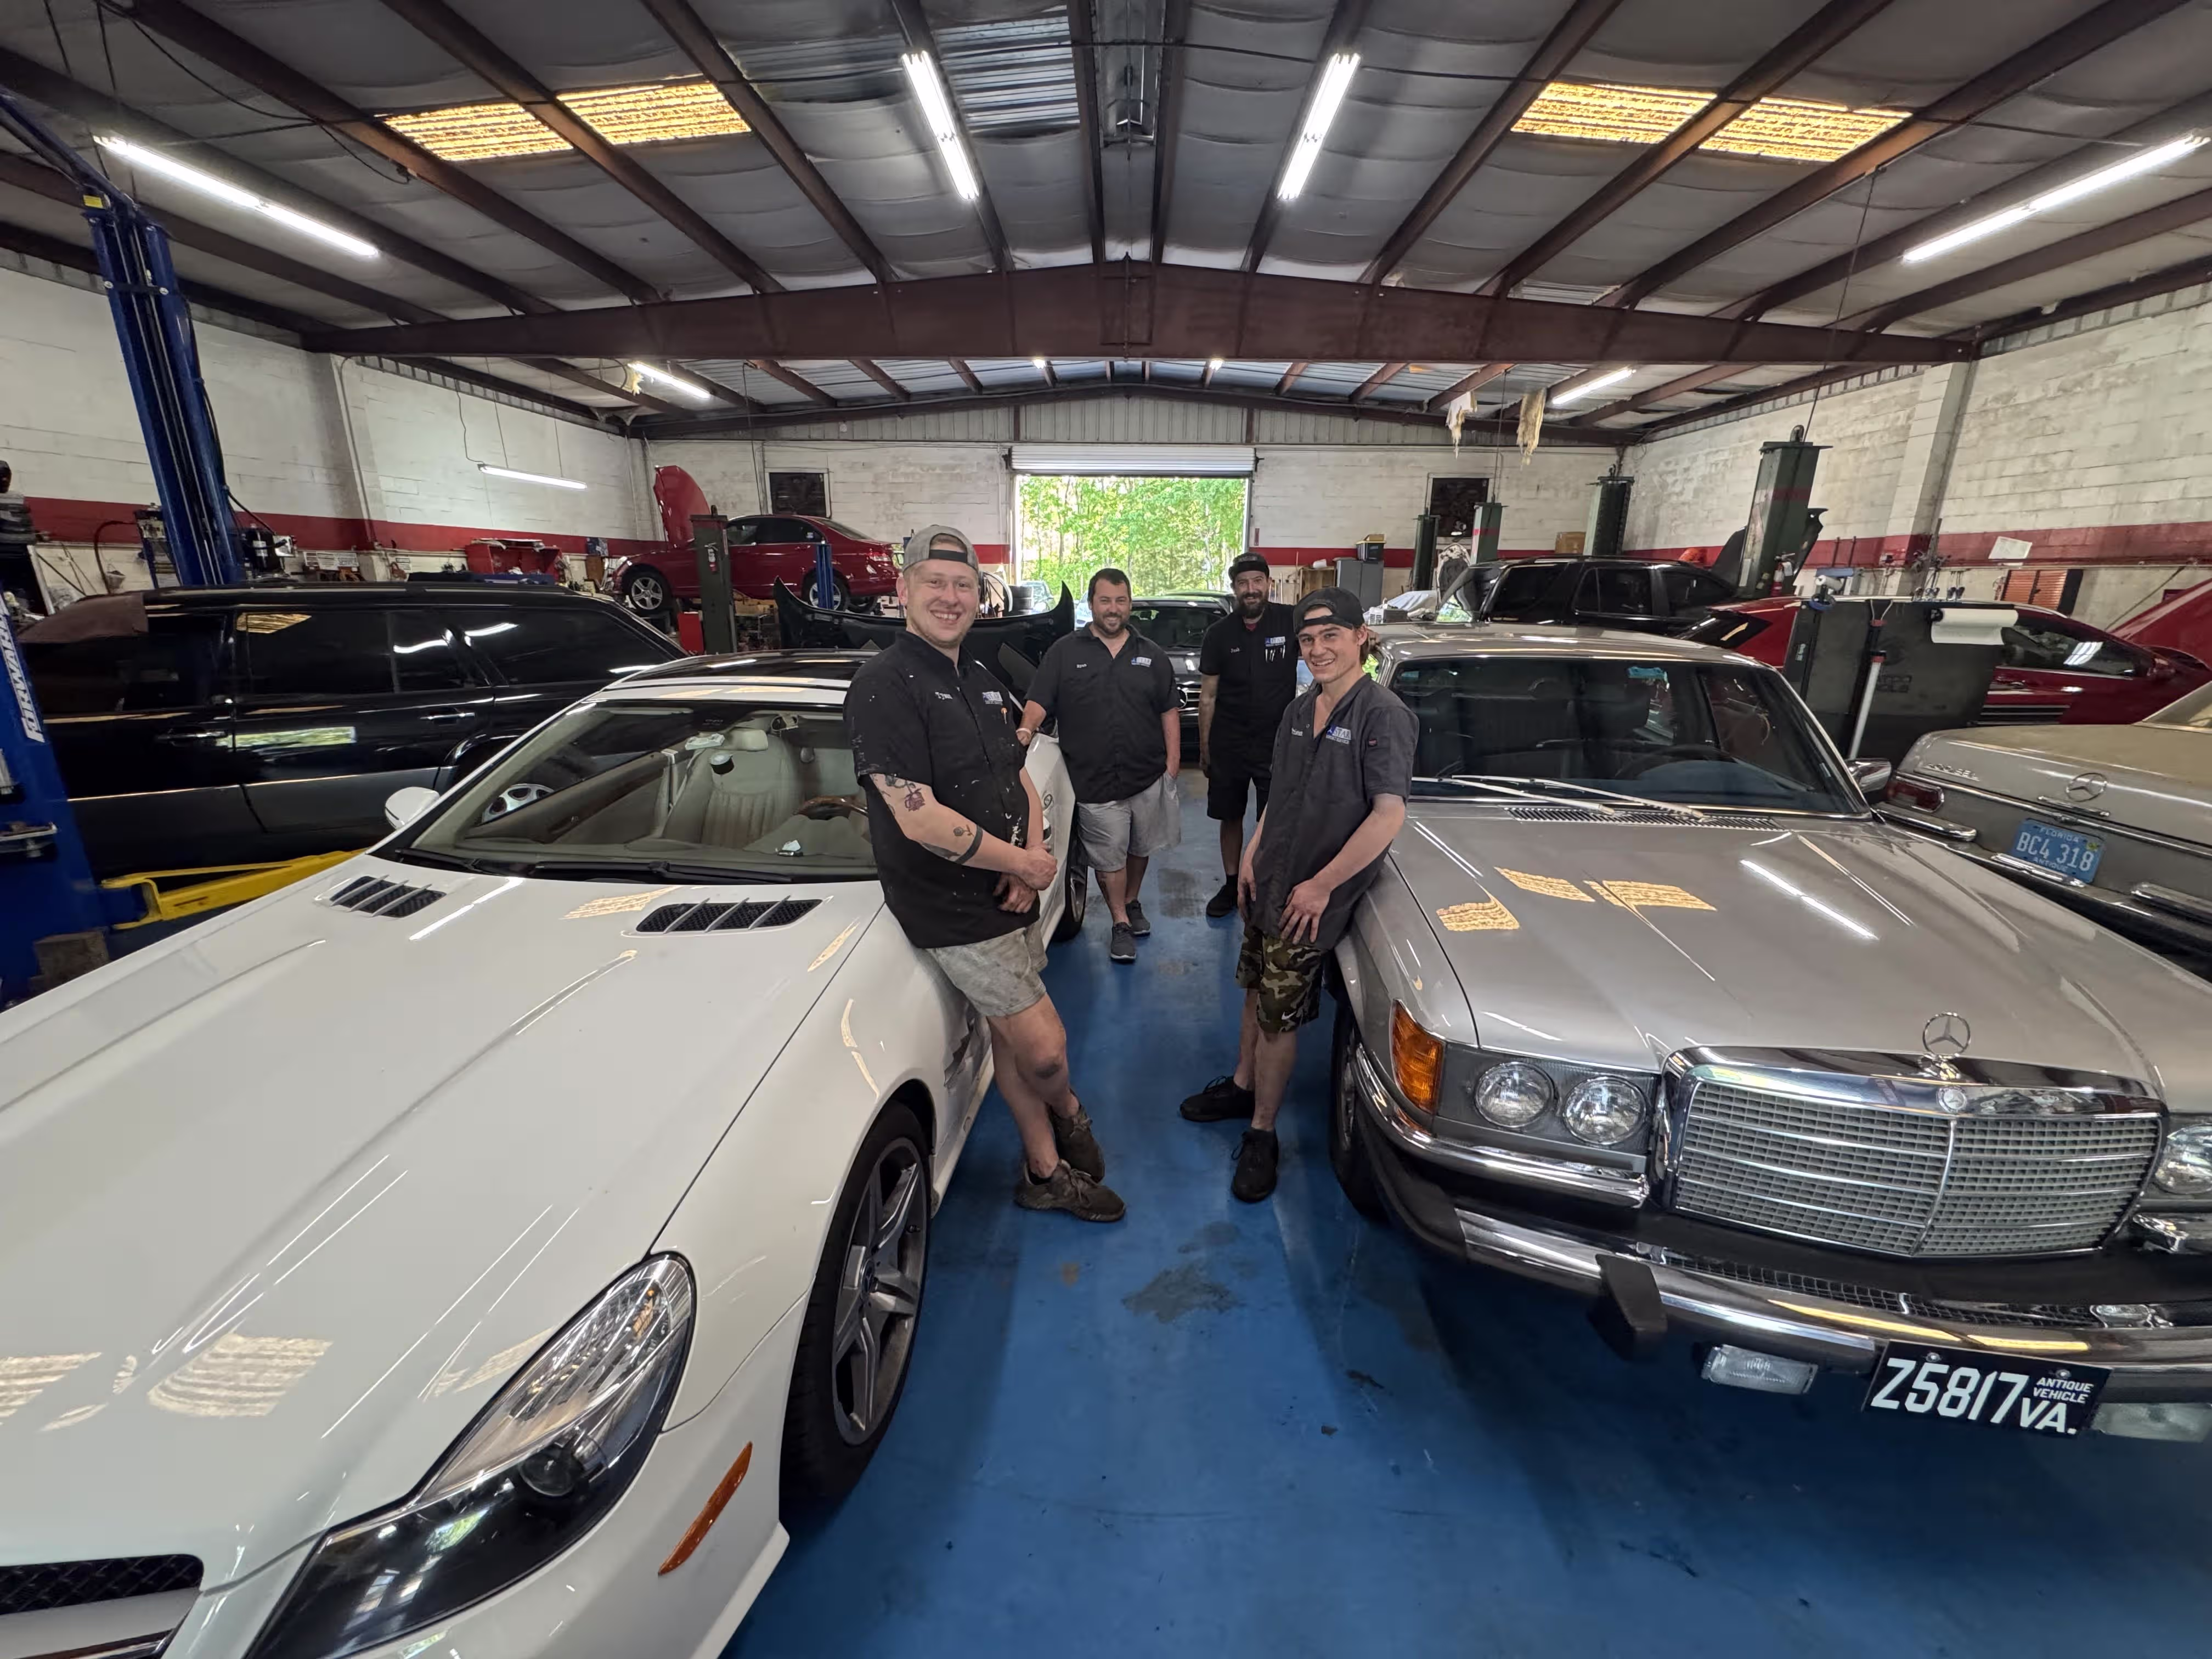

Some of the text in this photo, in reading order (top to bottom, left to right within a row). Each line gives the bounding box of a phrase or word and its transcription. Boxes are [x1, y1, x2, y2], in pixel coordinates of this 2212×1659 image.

[1334, 728, 1351, 739] STAR
[2039, 827, 2079, 843] FLORIDA
[2016, 832, 2094, 872] BC4 318
[2032, 857, 2068, 872] ANTIQUE
[1871, 1358, 2029, 1424] Z5817
[2036, 1377, 2094, 1393] ANTIQUE
[2033, 1387, 2088, 1403] VEHICLE
[2020, 1397, 2077, 1435] VA.
